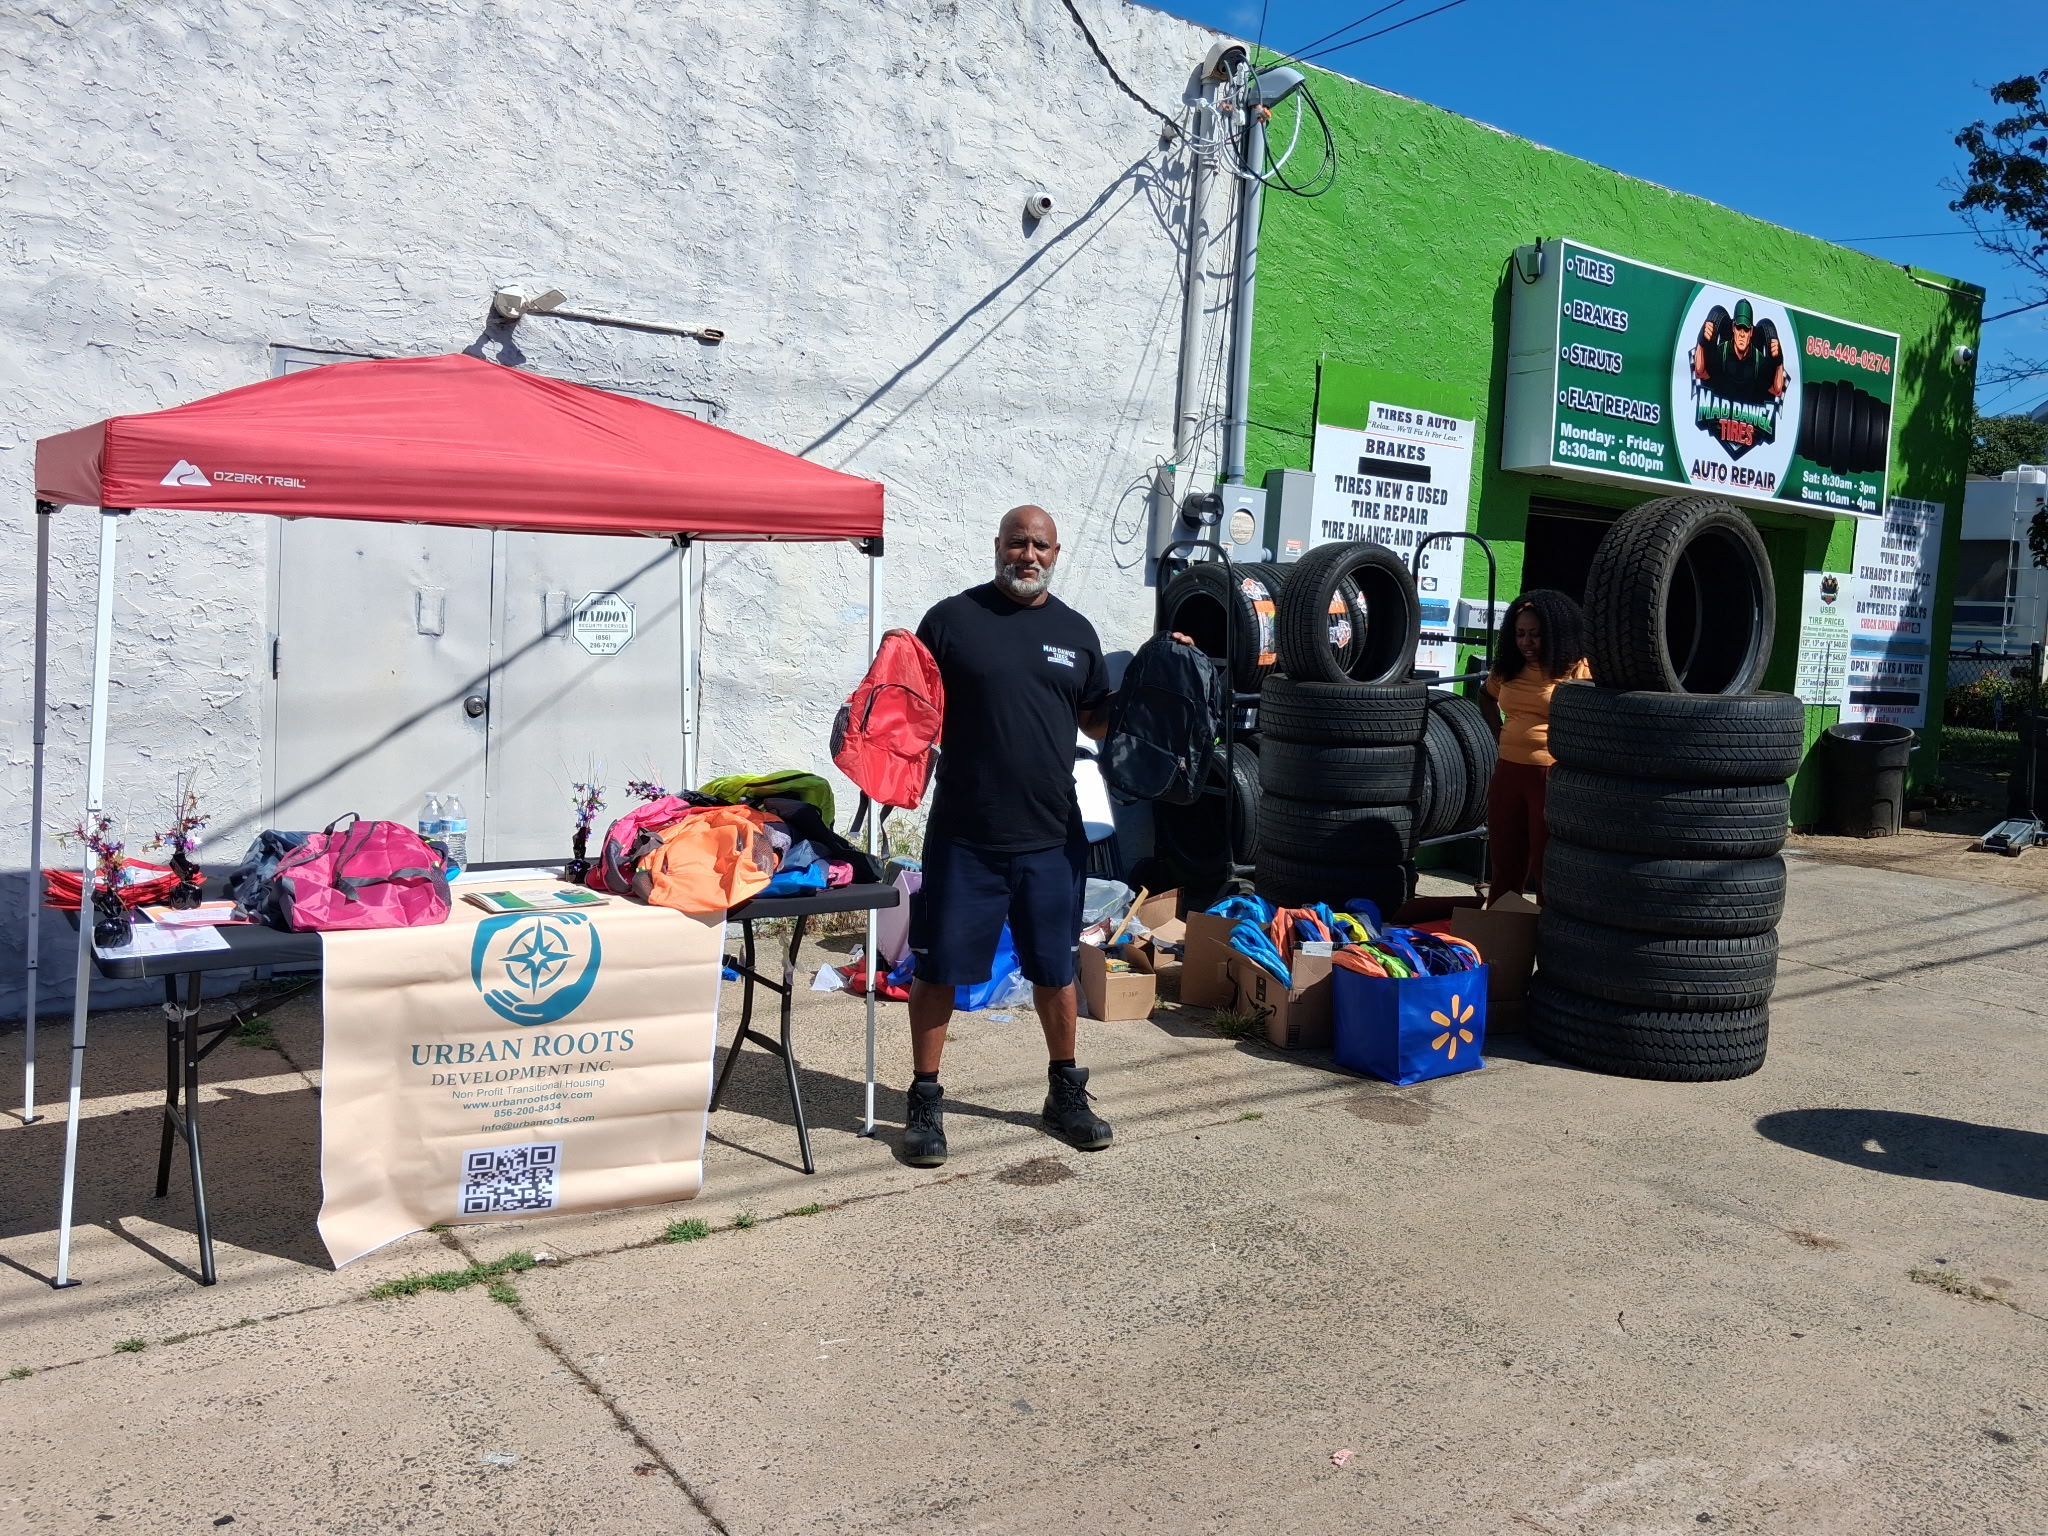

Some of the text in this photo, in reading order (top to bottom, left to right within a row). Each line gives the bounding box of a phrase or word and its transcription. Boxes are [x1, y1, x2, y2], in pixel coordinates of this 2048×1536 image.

[1573, 256, 1615, 285] TIRES
[1572, 300, 1628, 332] BRAKES
[1569, 343, 1623, 373] STRUTS
[1805, 335, 1891, 375] 856-448-0274
[1568, 387, 1660, 424] FLAT REPAIRS
[1698, 387, 1775, 435] MAD DAWGZ
[1376, 407, 1457, 431] TIRES & AUTO
[1413, 428, 1424, 436] Fix
[1560, 422, 1616, 446] Monday:
[1626, 434, 1665, 454] Friday
[1719, 418, 1755, 446] TIRES
[1365, 438, 1426, 461] BRAKES
[1559, 440, 1608, 462] 8:30am
[1618, 450, 1664, 472] 6:00pm
[213, 471, 305, 488] OZARK TRAIL
[1690, 458, 1776, 492] AUTO REPAIR
[1802, 470, 1819, 487] Sat:
[1822, 474, 1853, 493] 8:30am
[1859, 482, 1877, 496] 3pm
[1335, 475, 1449, 506] TIRES NEW & USED
[1801, 486, 1822, 502] Sun:
[1824, 490, 1850, 506] 10am
[1857, 496, 1876, 512] 4pm
[1351, 500, 1429, 525] TIRE REPAIR
[1918, 502, 1936, 513] AUTO
[1321, 520, 1345, 539] TIRE
[1884, 522, 1918, 536] BRAKES
[1880, 536, 1917, 552] RADIATOR
[1880, 552, 1915, 567] TUNE UPS
[1860, 566, 1931, 586] EXHAUST & MUFFLER
[1869, 585, 1918, 602] STRUTS & SHOCKS
[579, 611, 628, 622] HADDON
[1820, 606, 1836, 614] USED
[1856, 602, 1927, 619] BATTERIES & BELTS
[1809, 616, 1845, 626] TIRE PRICES
[1043, 644, 1057, 653] MAD
[1851, 661, 1870, 672] OPEN
[1878, 662, 1896, 673] DAYS
[1898, 663, 1902, 674] A
[1904, 663, 1923, 675] WEEK
[411, 1029, 634, 1066] URBAN ROOTS
[431, 1060, 615, 1086] DEVELOPMENT INC.
[452, 1078, 605, 1099] Non Profit Transitional Housing
[463, 1090, 593, 1110] www.urbanrootsdev.com
[494, 1101, 562, 1118] 856-200-8434
[481, 1114, 595, 1132] info@urbanroots.com
